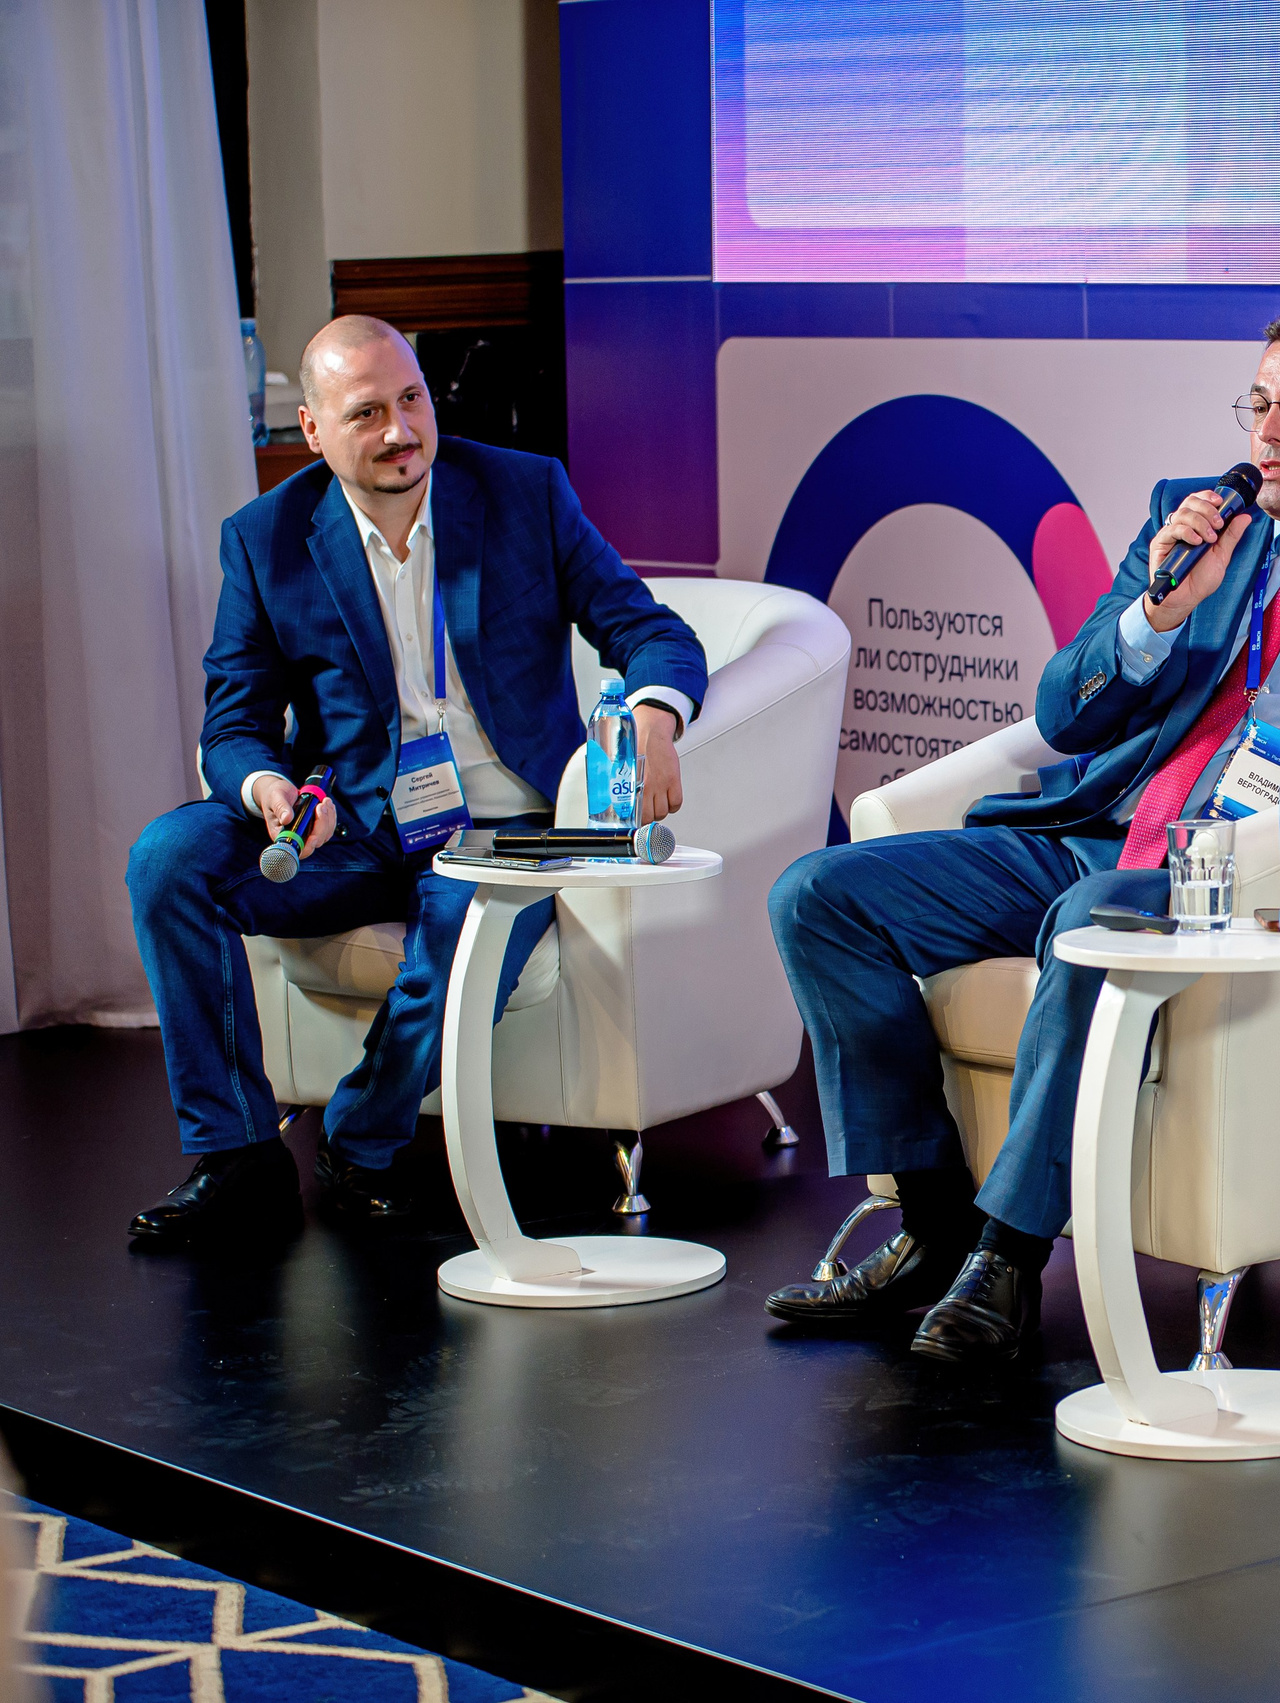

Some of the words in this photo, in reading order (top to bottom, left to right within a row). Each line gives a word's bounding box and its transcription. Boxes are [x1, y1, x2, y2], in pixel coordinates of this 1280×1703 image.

[867, 598, 1003, 640] Пользуются
[855, 647, 882, 669] ли
[886, 649, 1019, 683] сотрудники
[853, 688, 1023, 724] возможностью
[839, 728, 970, 758] самостояте
[1237, 777, 1280, 805] ВЕРТОГРАД
[1248, 771, 1280, 792] ВЛАДИМ
